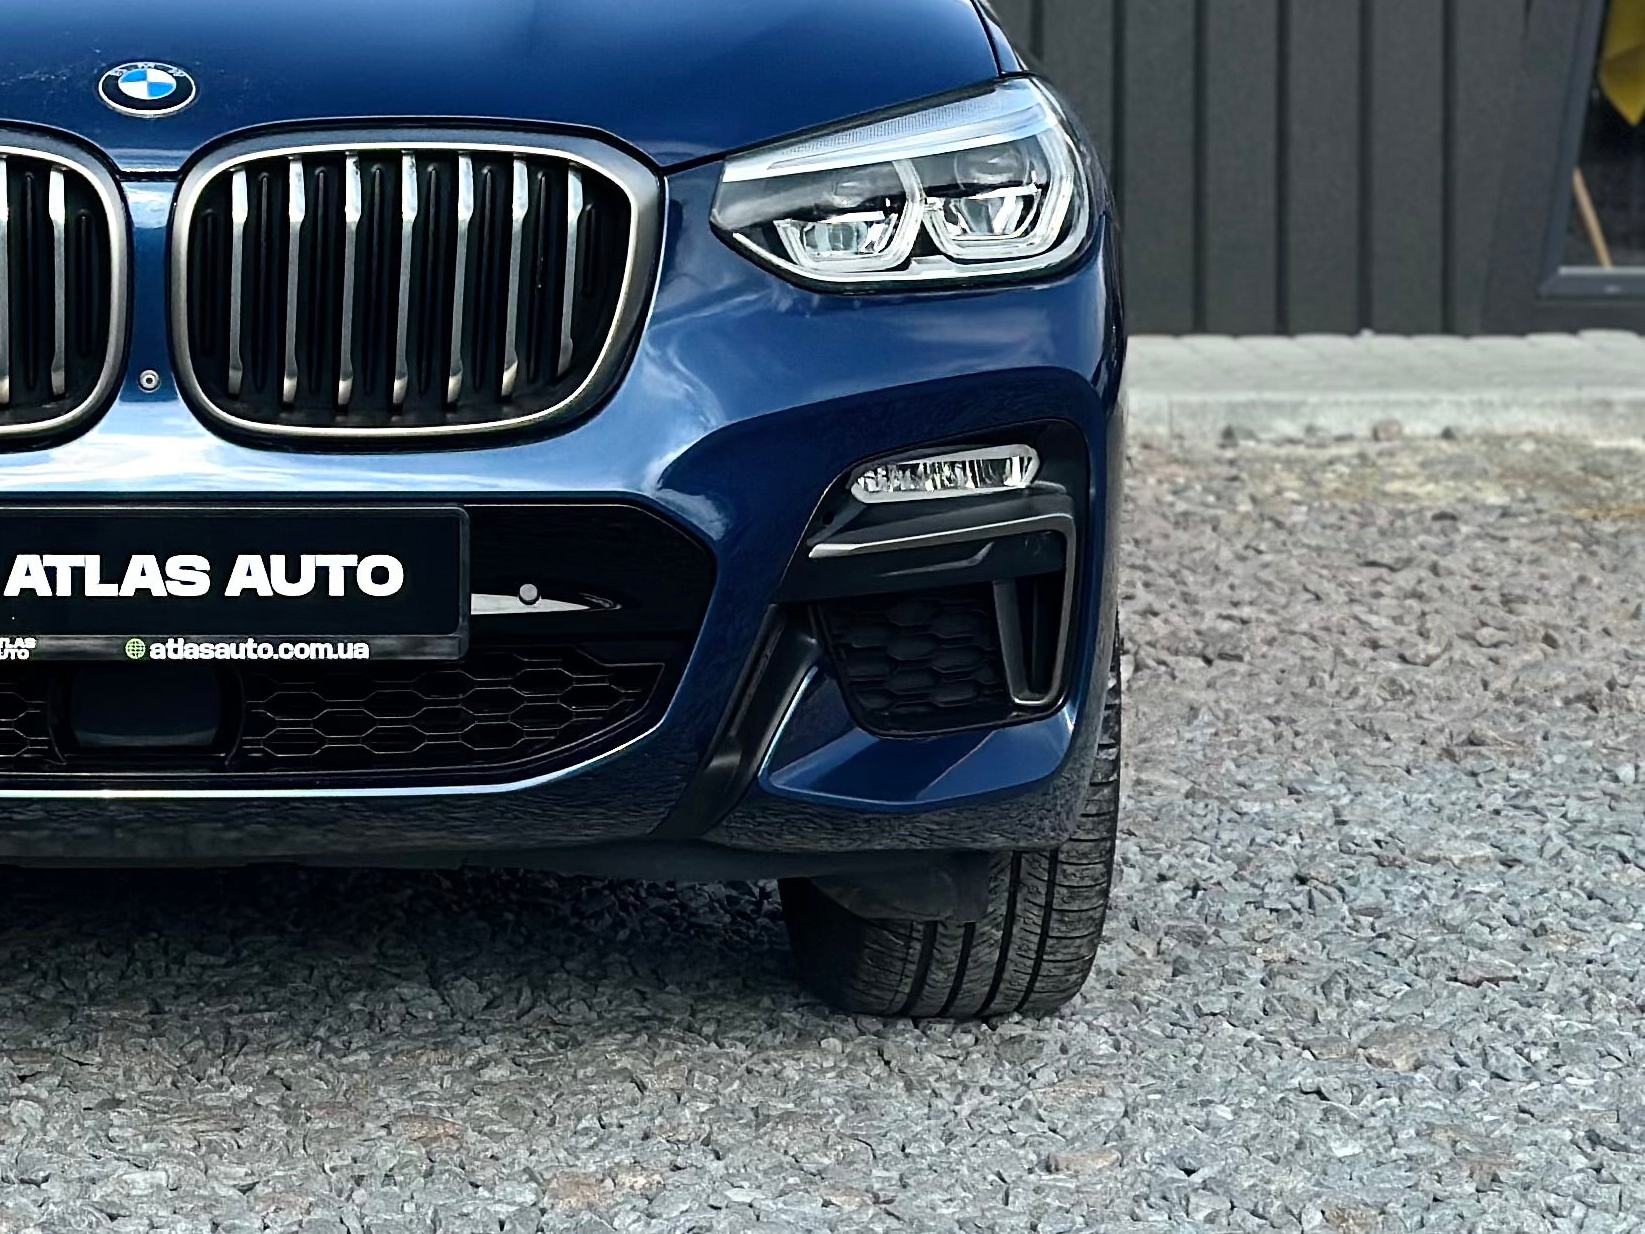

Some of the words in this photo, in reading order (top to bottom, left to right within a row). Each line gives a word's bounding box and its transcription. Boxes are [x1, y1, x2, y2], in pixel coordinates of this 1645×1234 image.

[3, 554, 211, 597] ATLAS
[224, 554, 404, 597] AUTO
[149, 637, 370, 660] atlasauto.com.ua
